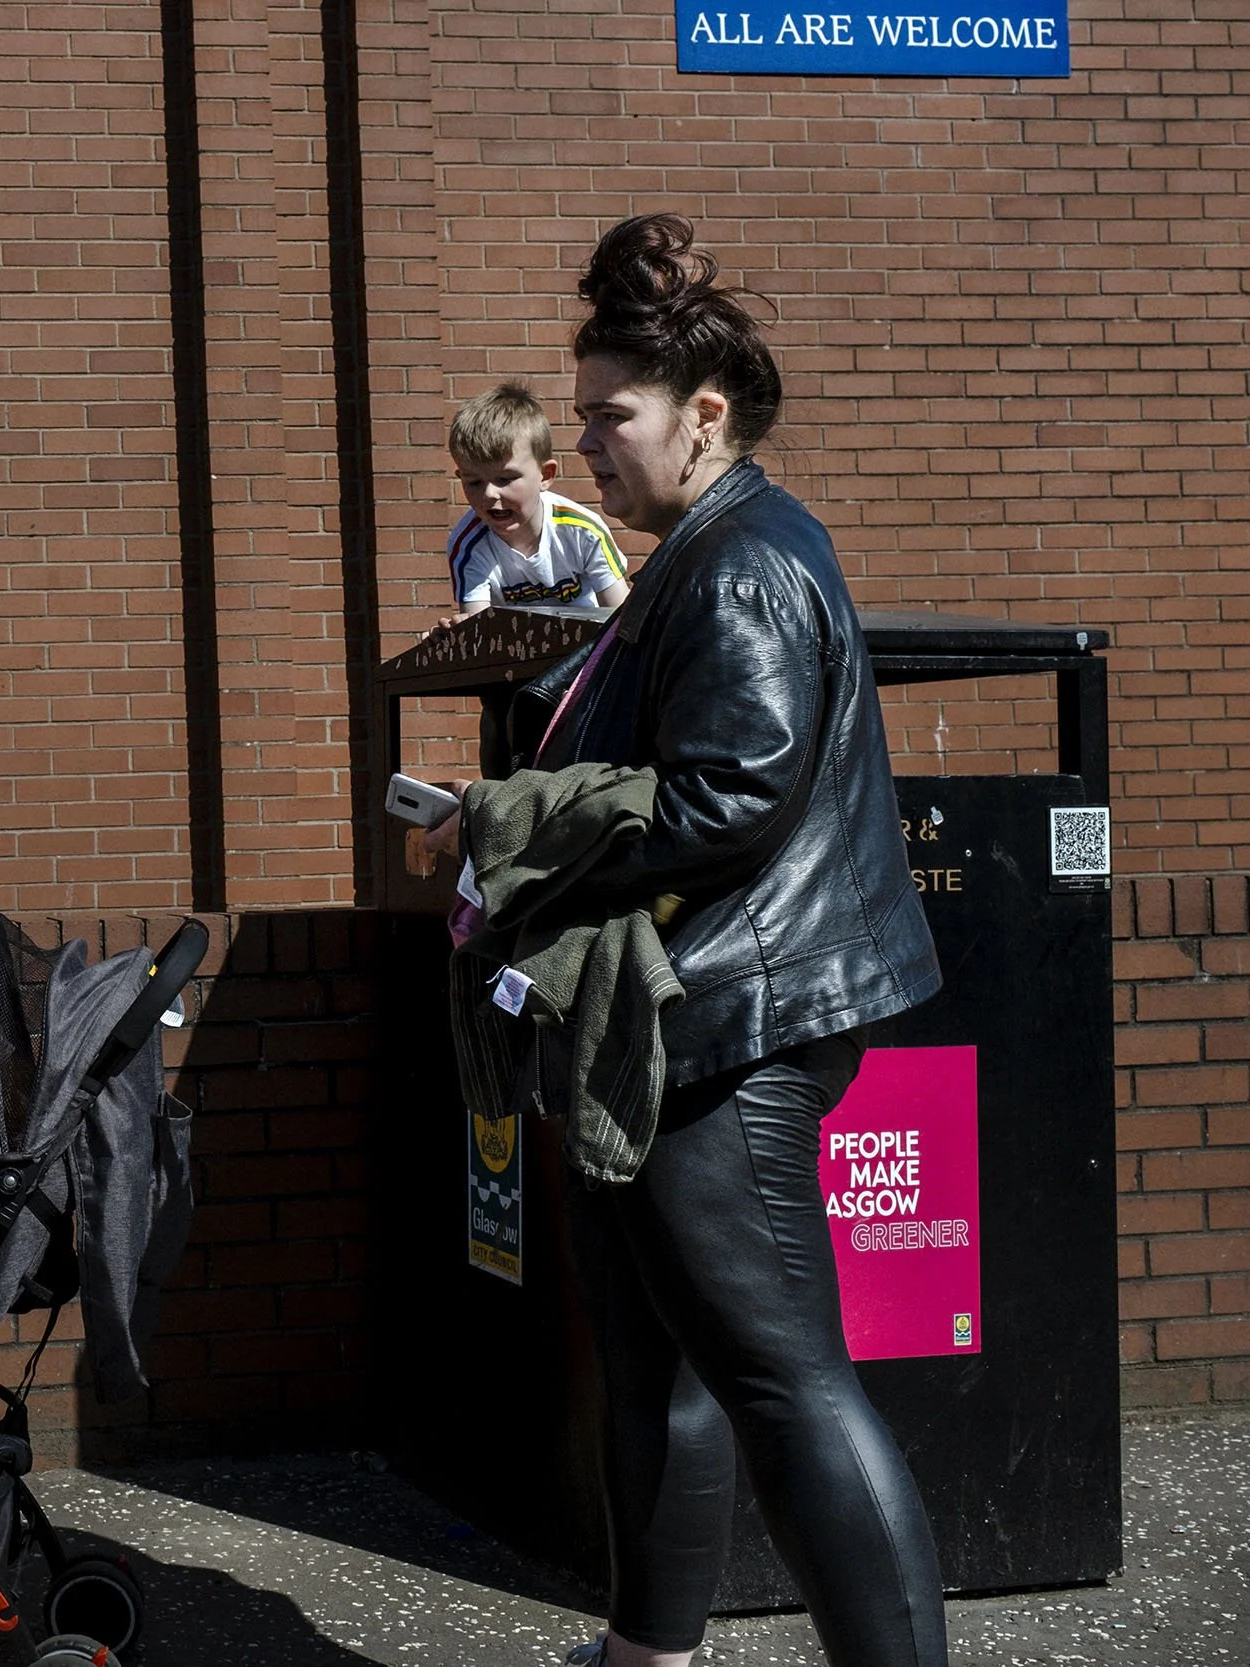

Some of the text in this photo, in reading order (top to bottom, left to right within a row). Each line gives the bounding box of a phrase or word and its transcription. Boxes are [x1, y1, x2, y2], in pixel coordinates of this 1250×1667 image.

[690, 12, 1058, 49] ALL ARE WELCOME
[830, 1130, 920, 1160] PEOPLE
[850, 1159, 920, 1188] MAKE
[826, 1189, 920, 1218] ASGOW
[851, 1219, 969, 1251] GREENER
